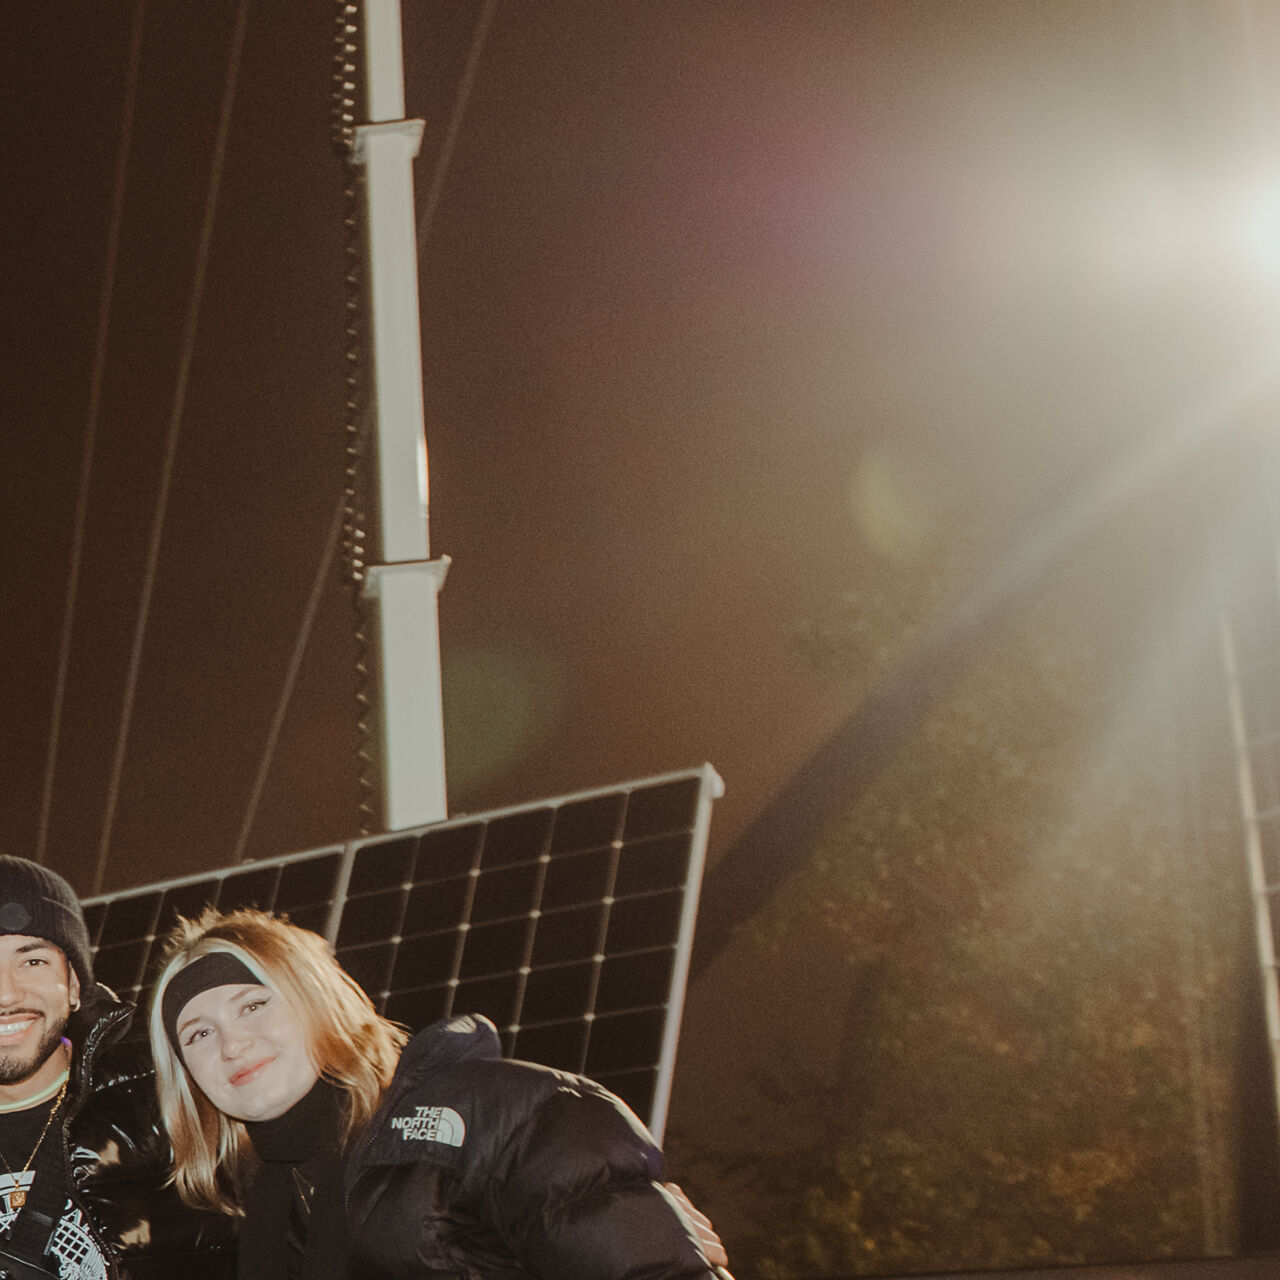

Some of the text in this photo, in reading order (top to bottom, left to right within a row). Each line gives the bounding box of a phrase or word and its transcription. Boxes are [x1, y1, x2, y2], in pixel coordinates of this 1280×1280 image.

[415, 1106, 441, 1118] THE
[391, 1117, 440, 1130] NORTH
[403, 1128, 437, 1141] FACE
